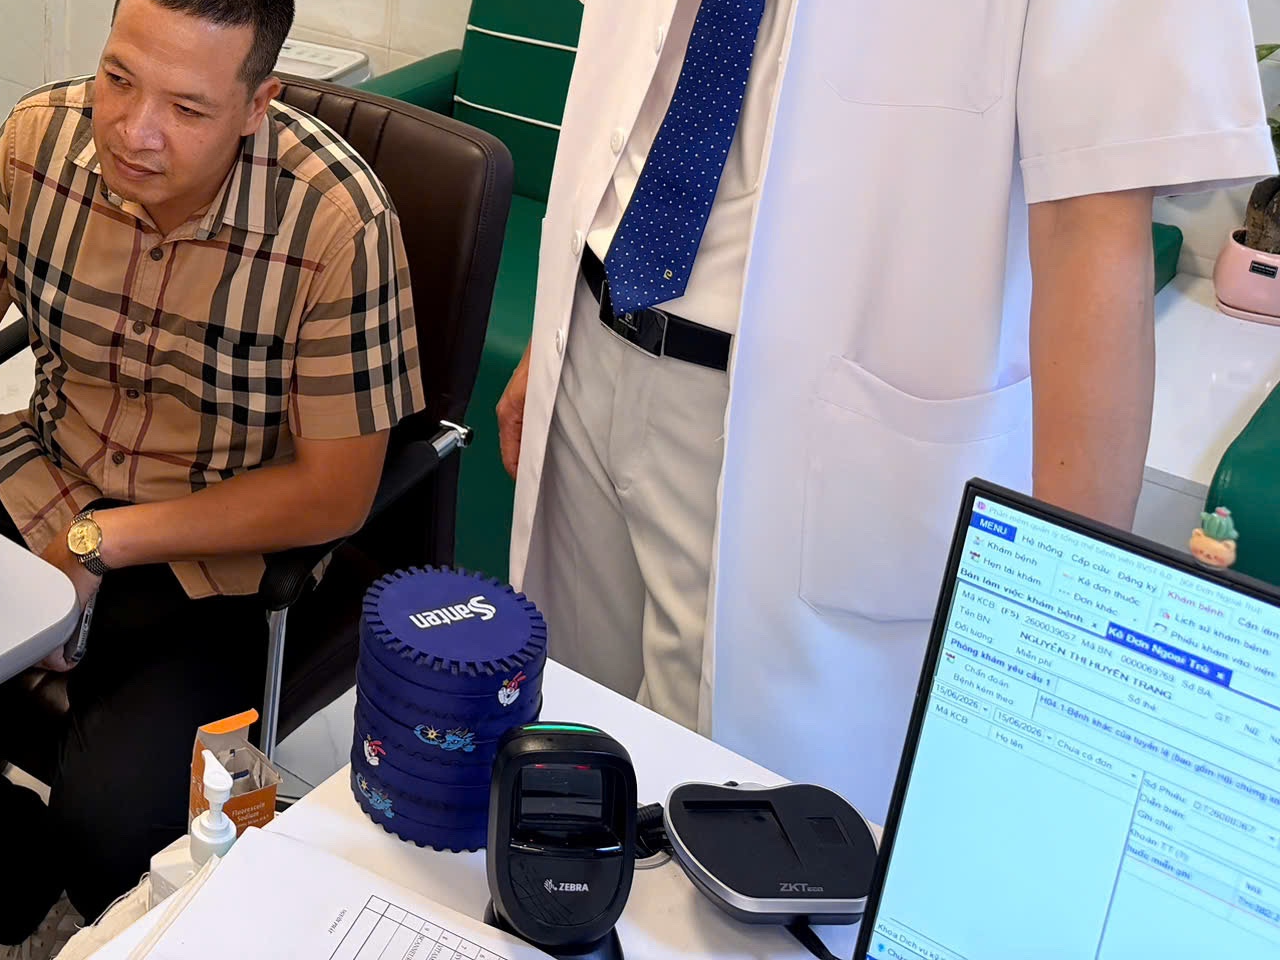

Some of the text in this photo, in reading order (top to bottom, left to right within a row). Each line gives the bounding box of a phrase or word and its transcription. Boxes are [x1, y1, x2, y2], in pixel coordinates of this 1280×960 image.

[979, 518, 1008, 535] MENU
[987, 541, 1012, 557] Khám
[409, 595, 497, 630] Santen
[936, 684, 978, 709] 15/06/2026
[1133, 677, 1172, 700] TRANG
[998, 711, 1042, 737] 15/06/2026
[559, 882, 589, 892] ZEBRA
